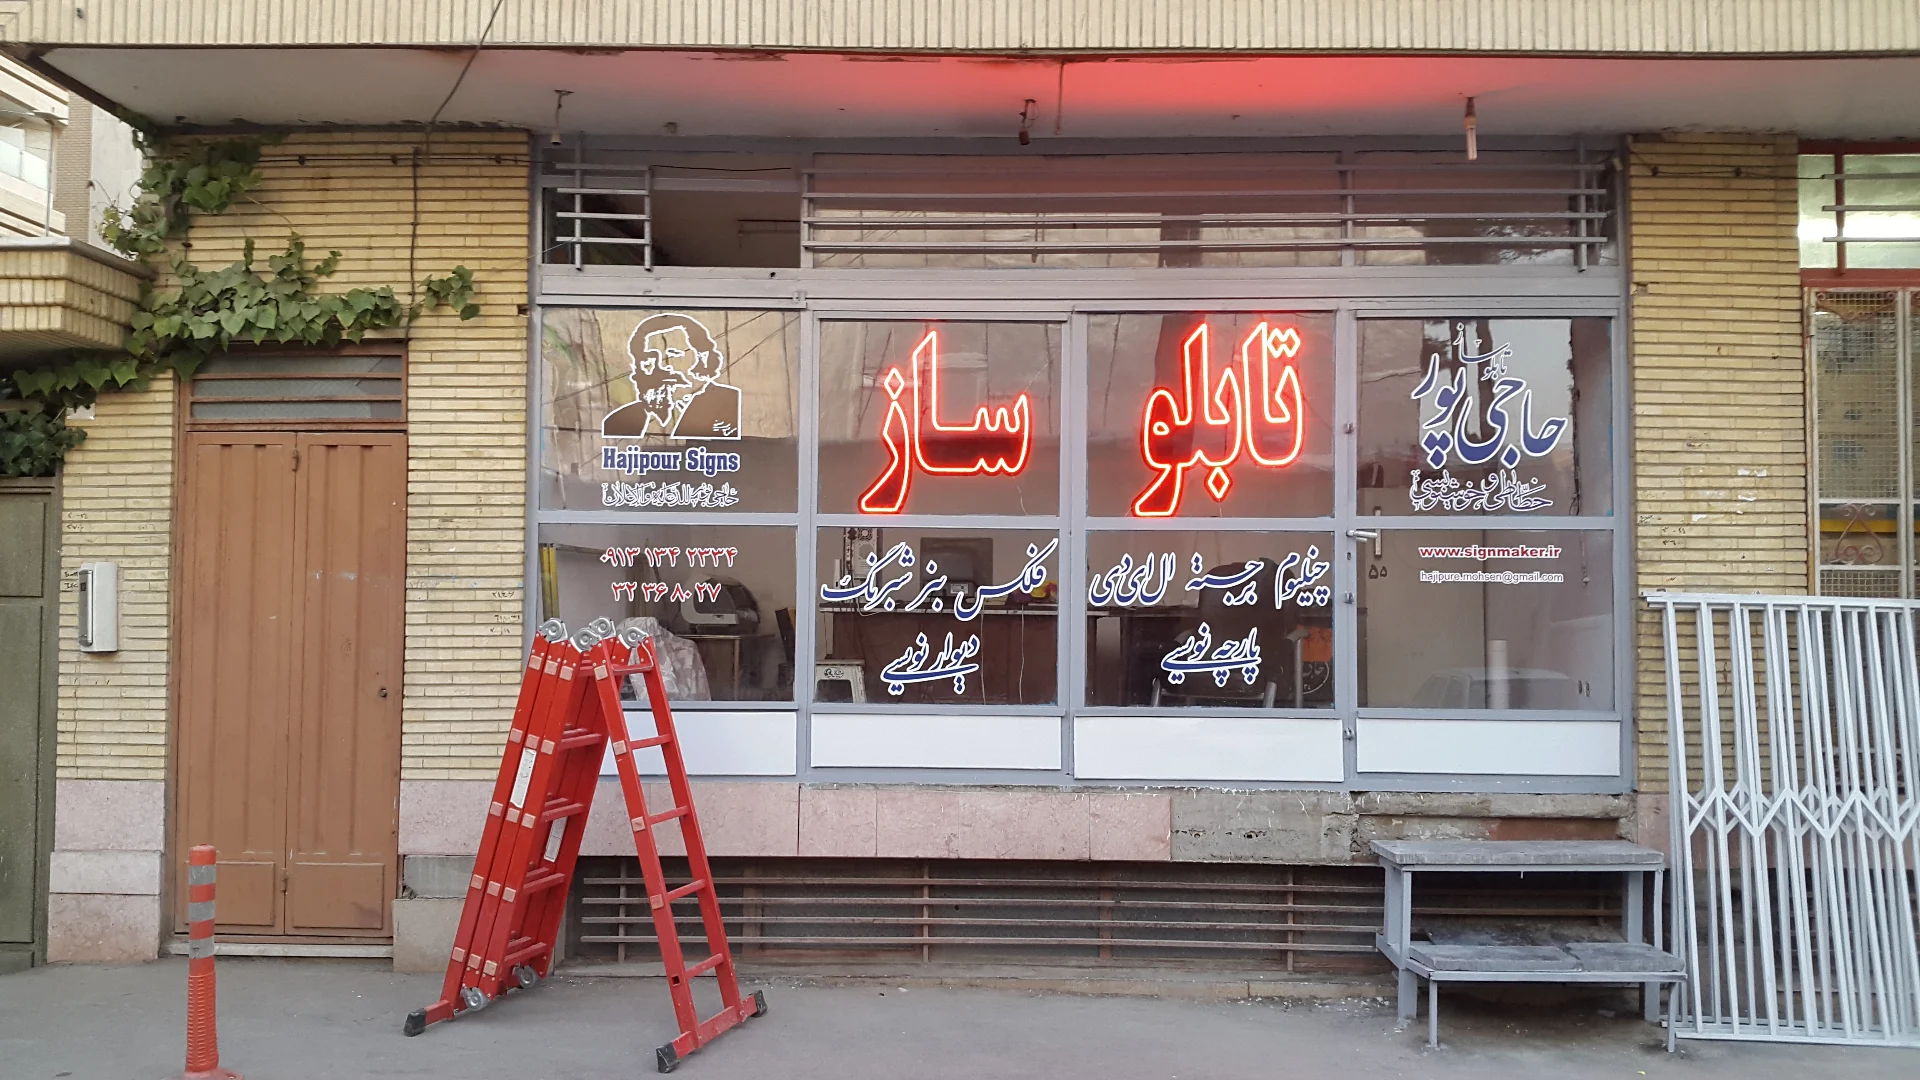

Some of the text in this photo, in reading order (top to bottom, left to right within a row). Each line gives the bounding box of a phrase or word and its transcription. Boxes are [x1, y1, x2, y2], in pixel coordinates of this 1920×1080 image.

[858, 321, 1302, 517] تابلو ساز
[1411, 352, 1568, 469] حاجی پور
[602, 446, 741, 478] Hajipour Signs
[599, 547, 739, 567] ۰۹۱۳ ۱۳۴ ۲۳۳۴
[1418, 545, 1562, 560] www.signmaker.ir
[611, 581, 638, 602] ۳۲
[820, 537, 1059, 621] فلکس بنر شبرنگ
[1419, 571, 1564, 583] hajipure.mohsen@gmail.com
[929, 631, 980, 695] دیوار
[1212, 626, 1261, 687] پارچه
